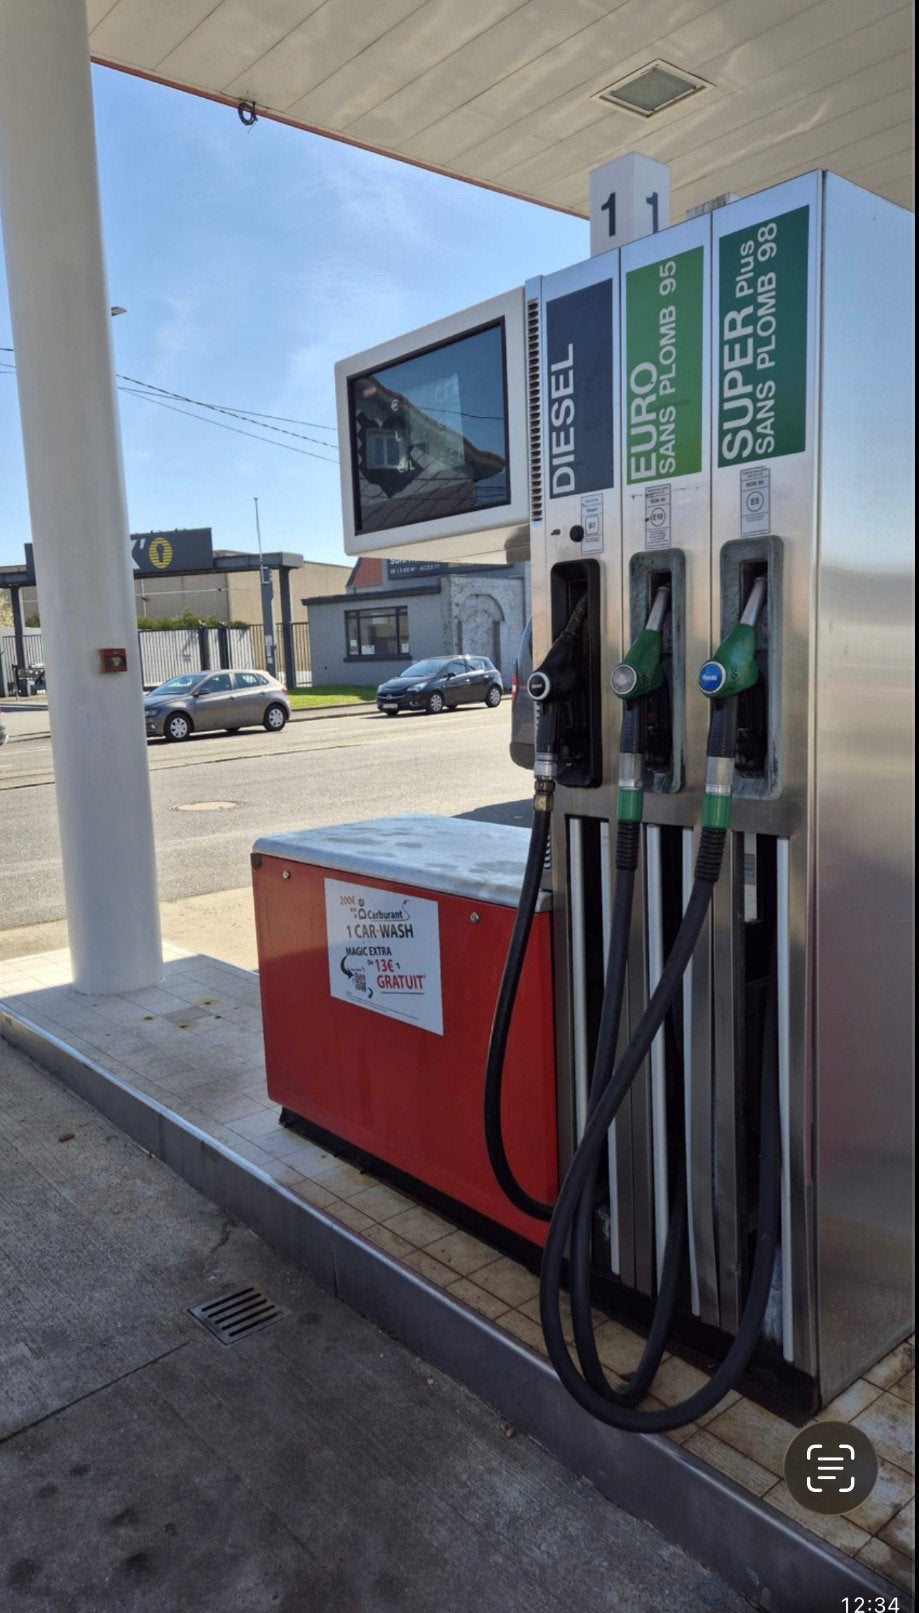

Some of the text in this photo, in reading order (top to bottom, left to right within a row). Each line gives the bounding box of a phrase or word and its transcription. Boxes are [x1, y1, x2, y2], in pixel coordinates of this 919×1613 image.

[601, 191, 616, 237] 1
[646, 191, 659, 234] 1
[736, 240, 755, 298] Plus
[755, 222, 777, 454] SANS PLOMB 98
[659, 260, 677, 474] SANS PLOMB 95
[722, 304, 754, 460] SUPER
[550, 343, 575, 495] DIESEL
[630, 361, 658, 480] EURO
[652, 513, 664, 521] E10
[346, 923, 414, 938] 1 CAR-WASH
[367, 910, 403, 920] Carburant
[345, 946, 392, 956] MAGIC EXTRA
[375, 958, 394, 973] 13€
